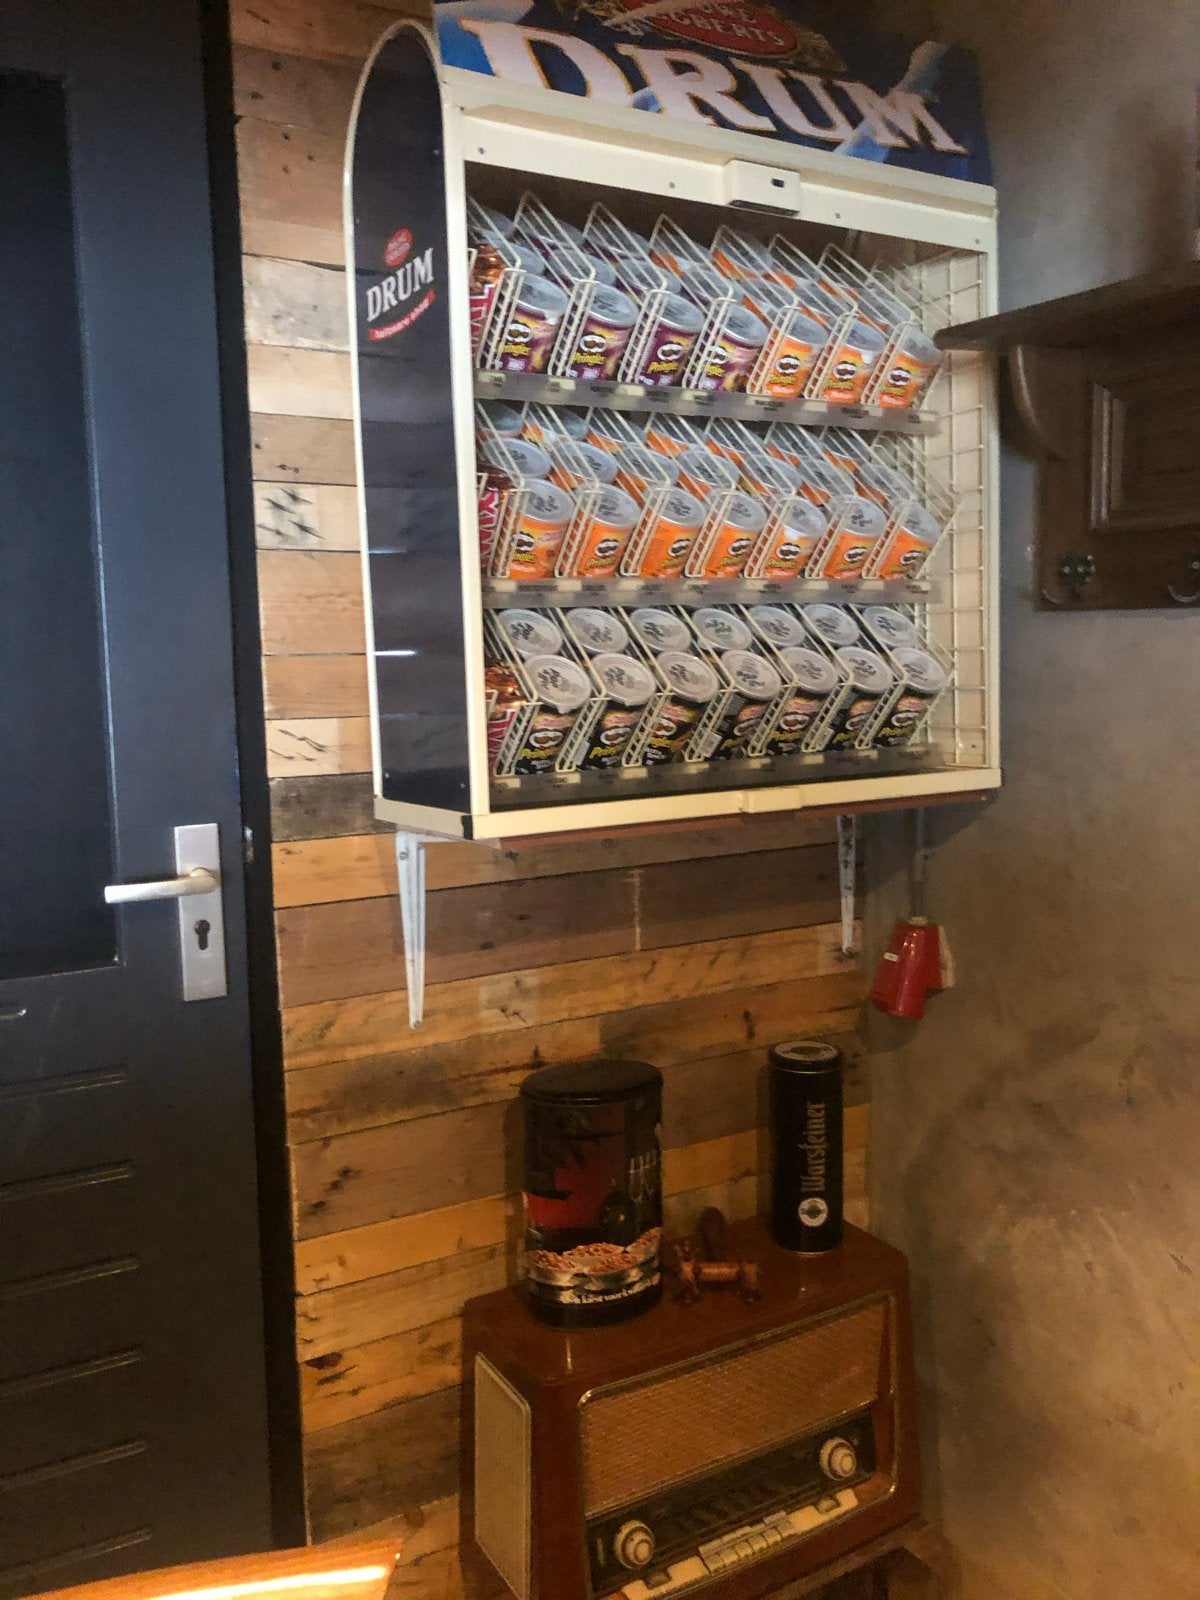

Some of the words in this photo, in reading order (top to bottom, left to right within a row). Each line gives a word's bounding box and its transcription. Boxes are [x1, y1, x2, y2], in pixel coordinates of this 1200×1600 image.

[459, 17, 969, 155] DRUM
[366, 247, 434, 322] DRUM
[798, 1101, 828, 1192] Warsteiner
